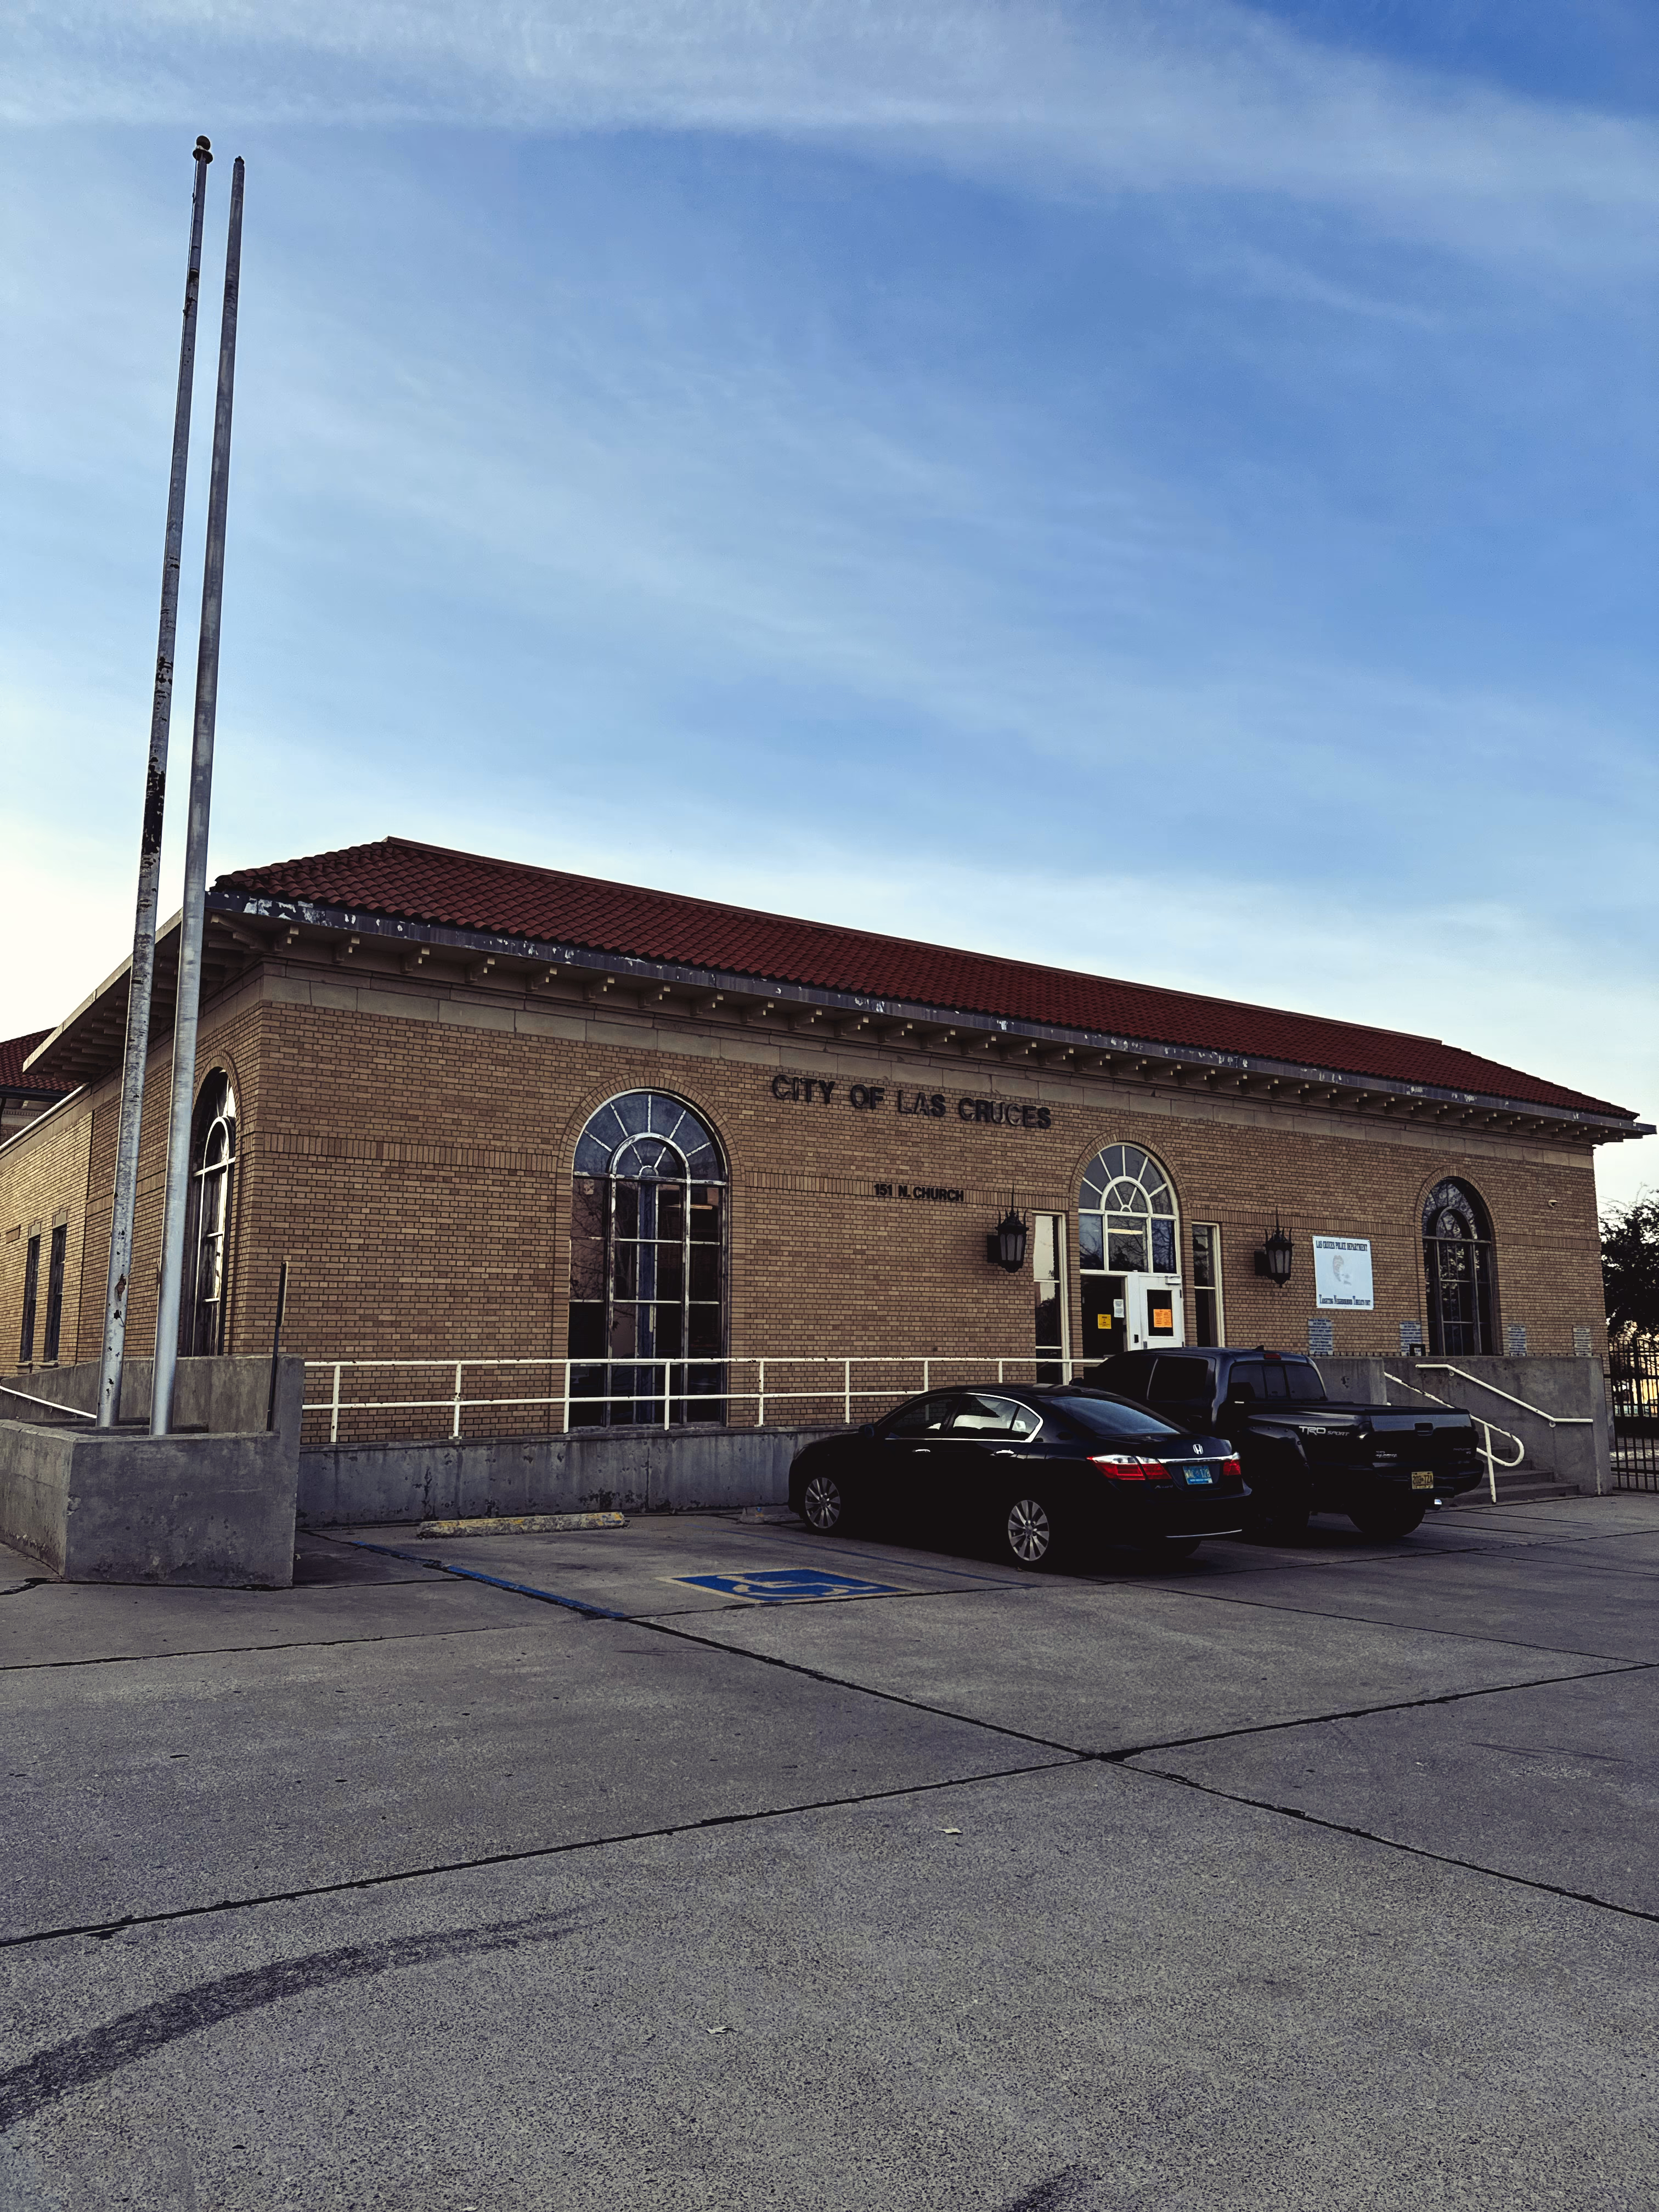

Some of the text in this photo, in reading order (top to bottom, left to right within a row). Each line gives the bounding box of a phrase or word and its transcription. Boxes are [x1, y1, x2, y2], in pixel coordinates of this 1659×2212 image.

[772, 1074, 1052, 1128] CITY OF LAS CRUCES
[874, 1183, 964, 1202] 151 N. CHURCH
[1323, 1241, 1335, 1249] CRUCES
[1347, 1243, 1367, 1251] DEPARTMENT
[1299, 1426, 1326, 1435] TRD
